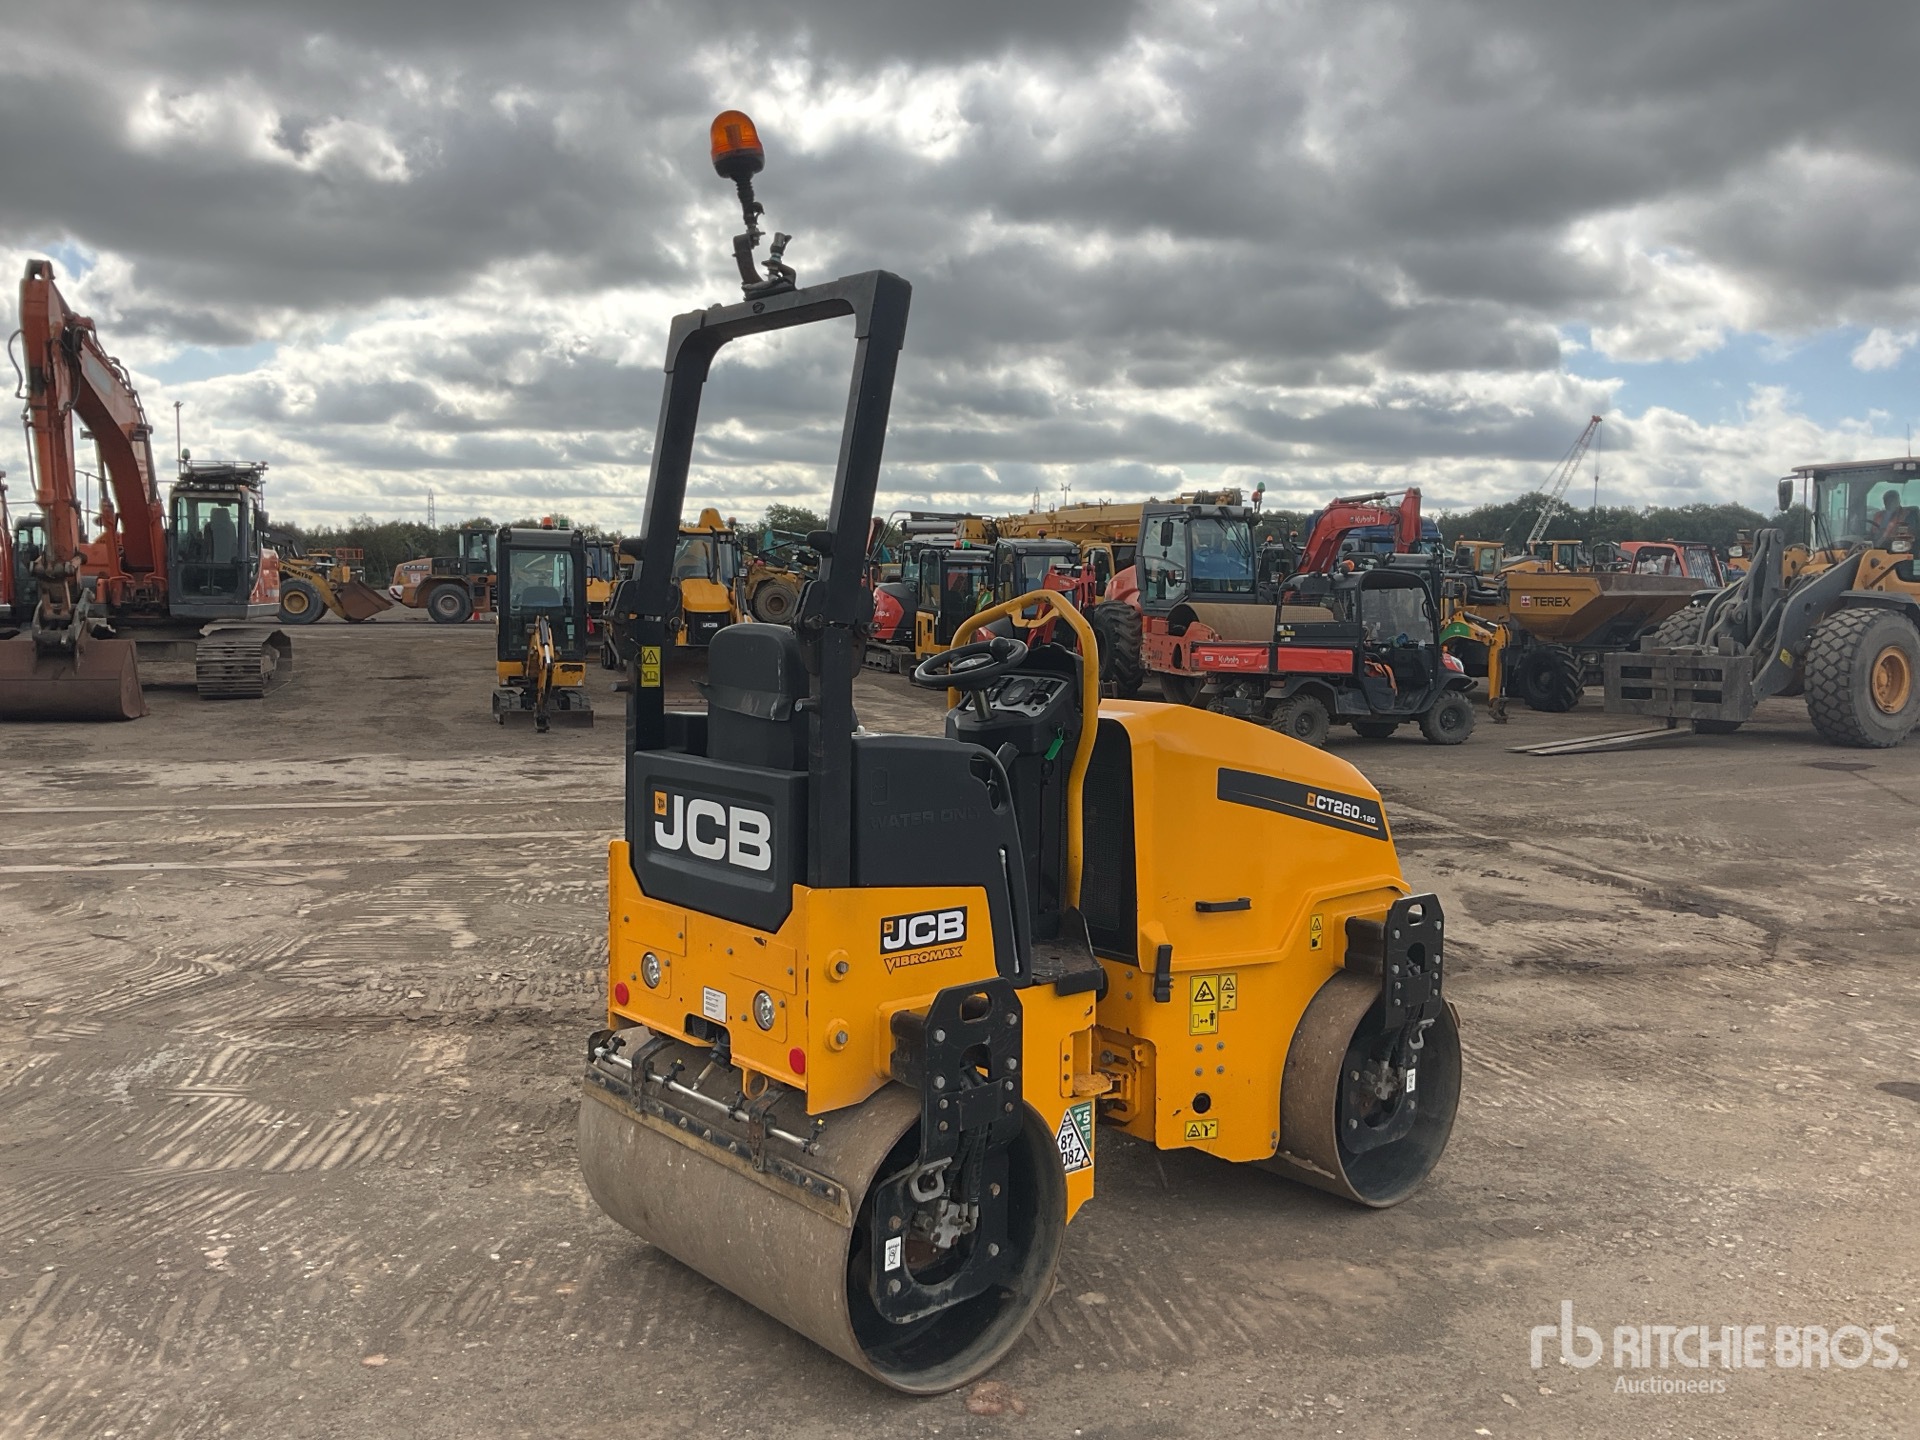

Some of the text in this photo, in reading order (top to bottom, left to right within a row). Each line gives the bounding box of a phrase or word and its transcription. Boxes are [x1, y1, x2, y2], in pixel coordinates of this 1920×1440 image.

[282, 565, 313, 581] KOMATSU
[1533, 596, 1571, 607] TEREX
[1218, 655, 1240, 664] Kubota
[868, 810, 934, 829] WATER
[654, 793, 772, 871] JCB
[883, 910, 965, 950] JCB
[884, 946, 963, 975] VIBROMAX
[1061, 1133, 1073, 1150] 87
